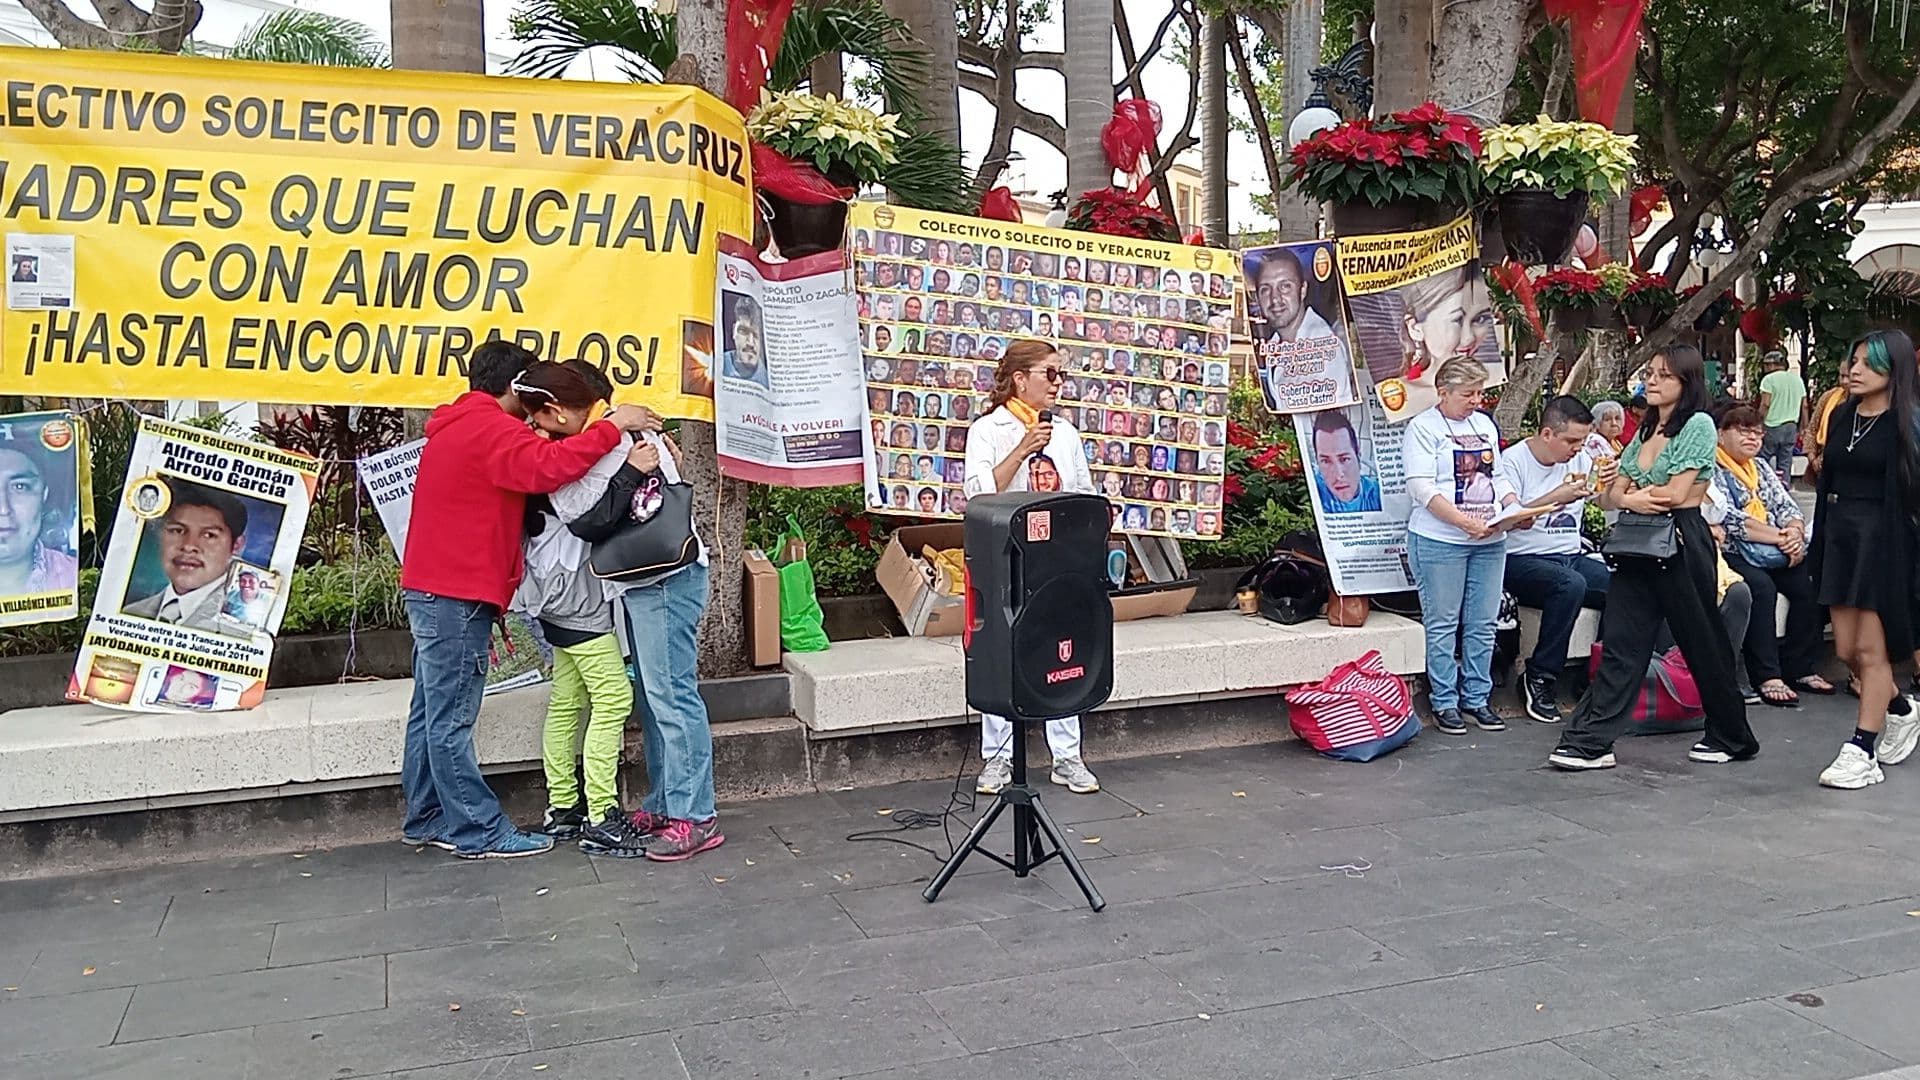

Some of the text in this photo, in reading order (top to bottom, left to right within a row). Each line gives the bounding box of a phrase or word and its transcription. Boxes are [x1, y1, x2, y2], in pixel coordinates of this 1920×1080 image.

[0, 81, 746, 186] ECTIVO SOLECITO DE VERACRUZ
[0, 161, 704, 254] ADRES QUE LUCHAN
[919, 219, 1171, 262] COLECTIVO SOLECITO DE VERACRUZ
[1340, 242, 1349, 254] Tu
[1351, 238, 1391, 253] Ausencia
[1394, 240, 1406, 250] me
[161, 241, 528, 313] CON AMOR
[1419, 258, 1447, 277] agosto
[1448, 251, 1461, 264] del
[24, 310, 208, 376] ¡HASTA
[1277, 342, 1295, 352] años
[1280, 381, 1335, 398] Roberto Carlos
[1310, 393, 1334, 404] Castro
[781, 424, 788, 432] A
[792, 419, 843, 431] VOLVER!
[144, 419, 319, 473] COLECTIVO SOLECITO DE VERACRUZ
[162, 441, 295, 486] Alfredo Román
[164, 457, 286, 498] Arroyo García
[369, 461, 383, 475] MI
[370, 471, 403, 491] DOLOR
[376, 486, 408, 505] HASTA
[95, 614, 264, 656] Se extravió entre las Trancas y Xalapa
[108, 626, 249, 662] Veracruz el 18 de Julio del 2011
[161, 650, 170, 660] A
[173, 652, 263, 679] ENCONTRARLO!
[1047, 666, 1084, 684] KAISER
